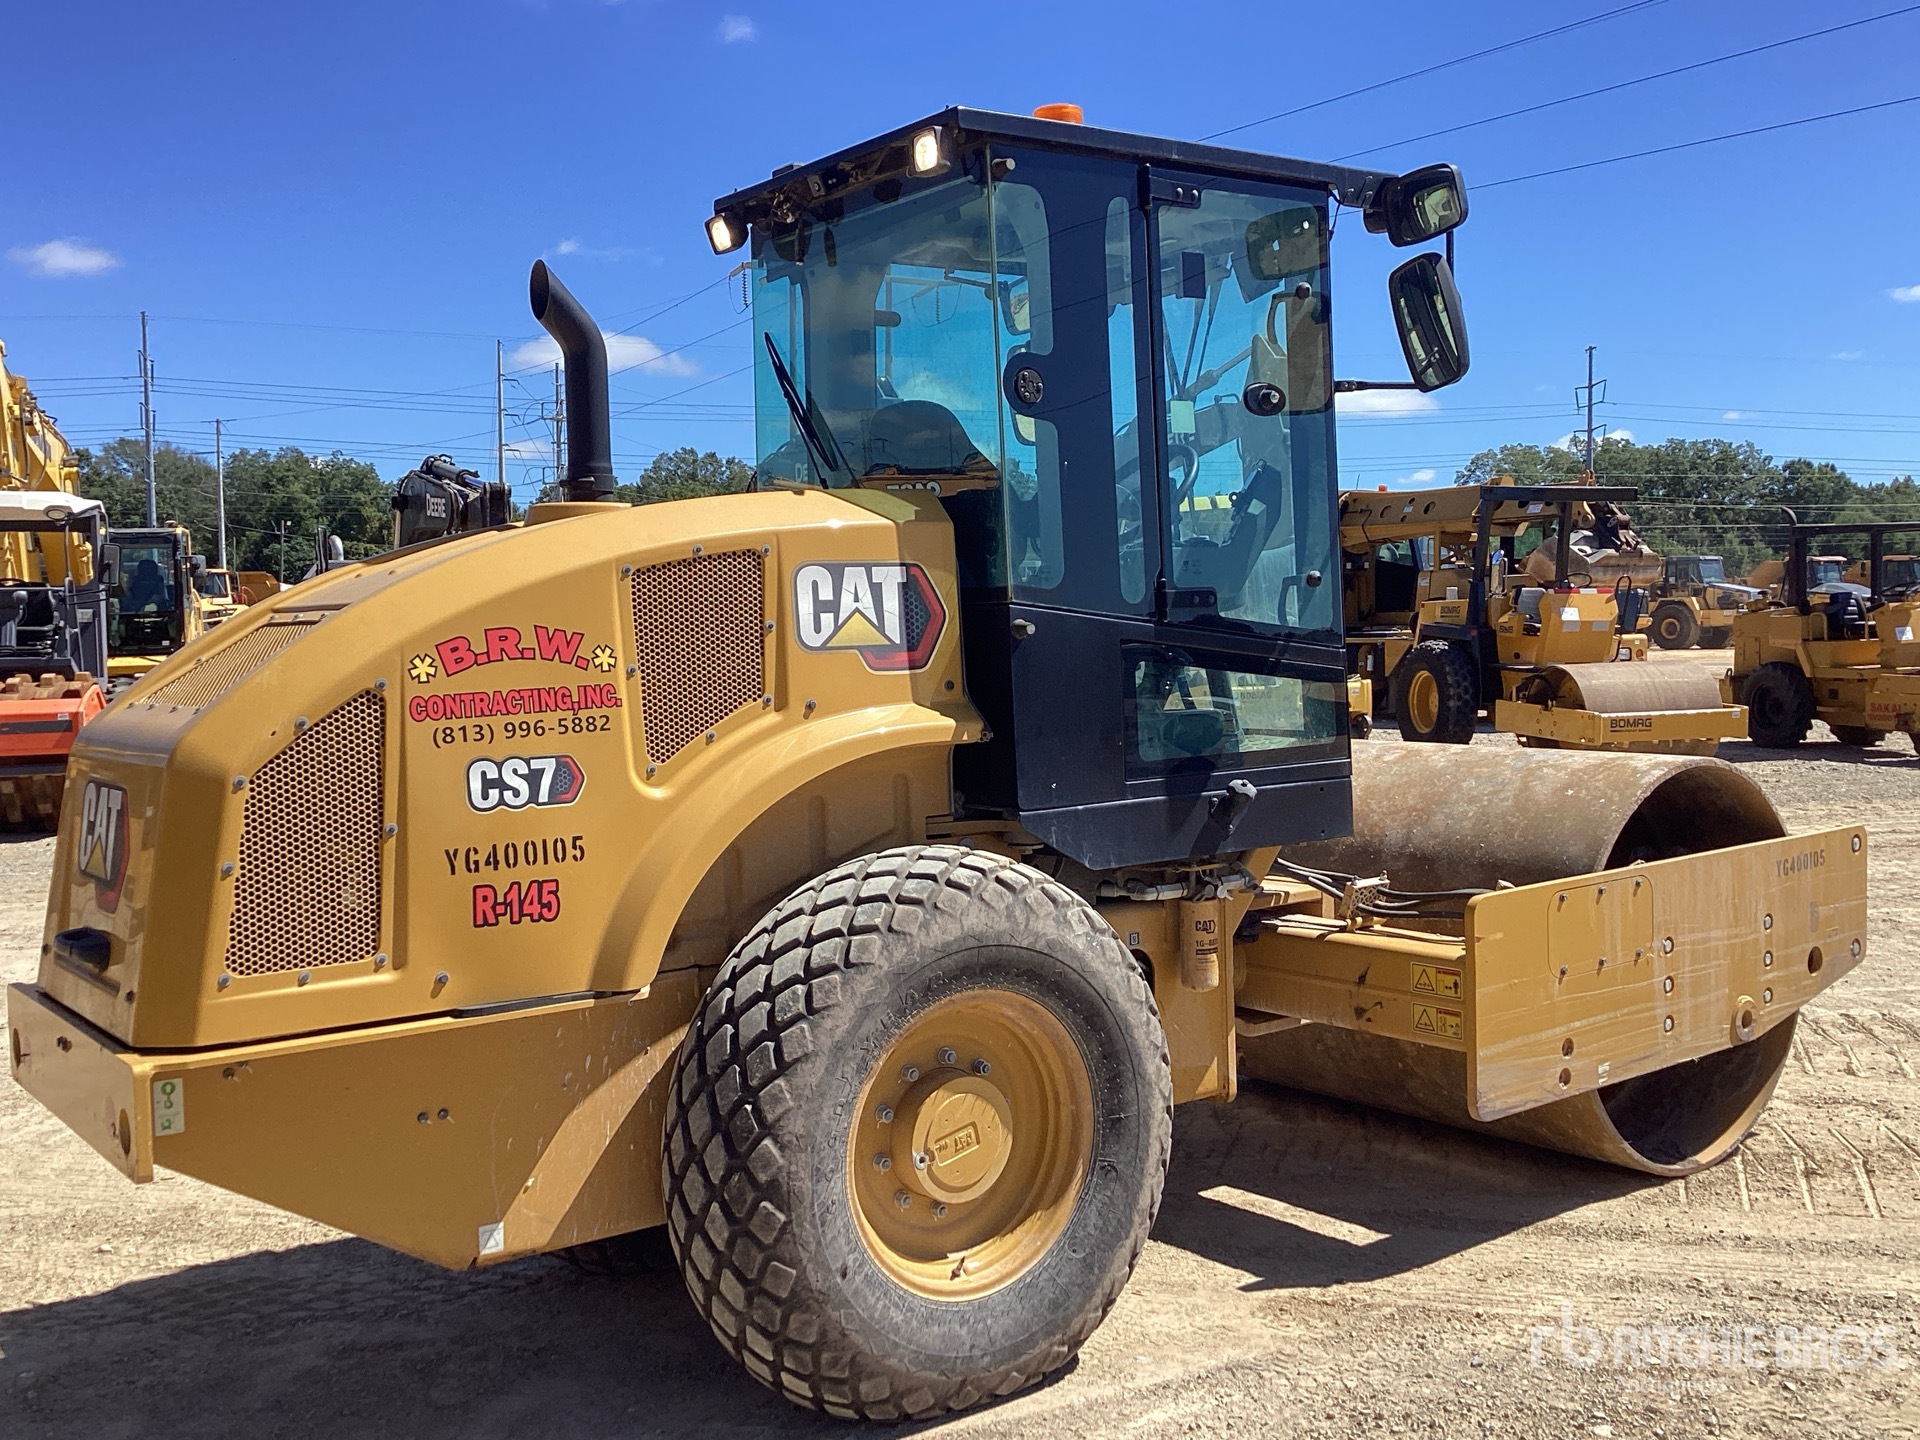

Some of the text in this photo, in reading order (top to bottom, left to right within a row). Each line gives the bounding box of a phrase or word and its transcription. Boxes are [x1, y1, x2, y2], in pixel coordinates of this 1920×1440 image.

[426, 493, 446, 518] DEERE
[797, 565, 906, 647] CAT
[435, 624, 590, 677] B.R.W.
[1610, 717, 1652, 729] BOMAG
[1870, 702, 1901, 713] SAKAI
[432, 714, 611, 748] (813) 996-5882
[469, 758, 556, 809] CS7
[80, 782, 122, 880] CAT
[444, 836, 585, 876] YG400105
[473, 879, 560, 928] R-145
[1196, 920, 1212, 931] CAT
